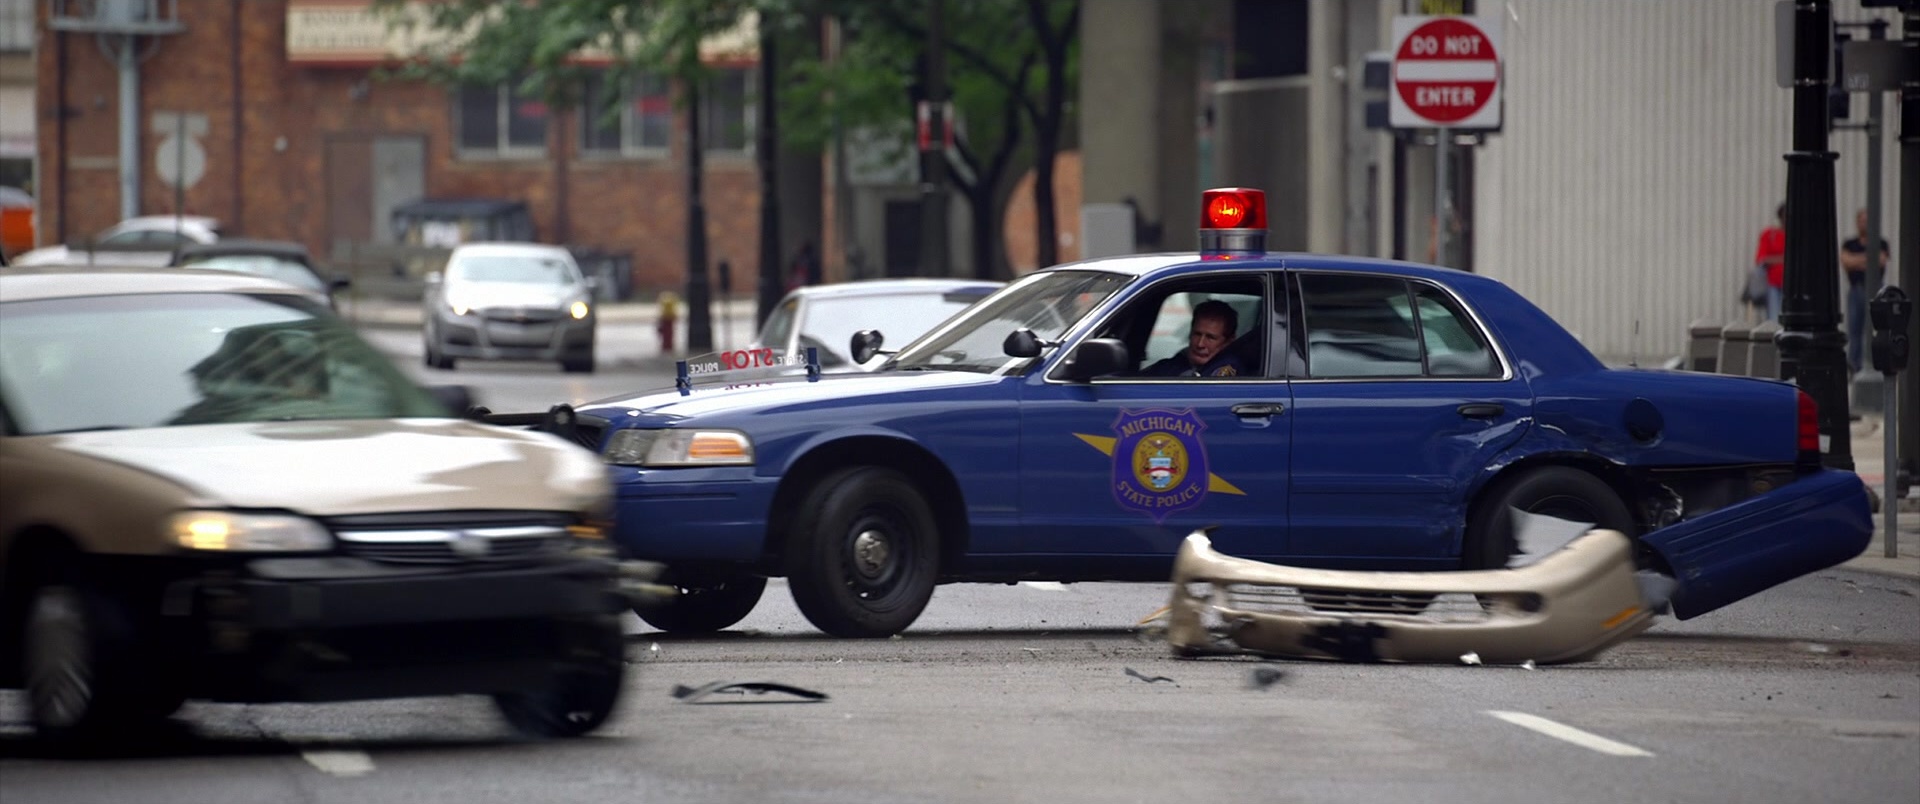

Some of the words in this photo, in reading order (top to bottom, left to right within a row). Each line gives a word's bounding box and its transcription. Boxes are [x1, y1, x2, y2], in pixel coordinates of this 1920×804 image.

[1411, 35, 1438, 55] DO
[1445, 35, 1481, 55] NOT
[1416, 86, 1475, 107] ENTER
[1121, 416, 1195, 438] MICHIGAN
[1117, 480, 1154, 507] STATE
[1156, 482, 1201, 508] POLICE
